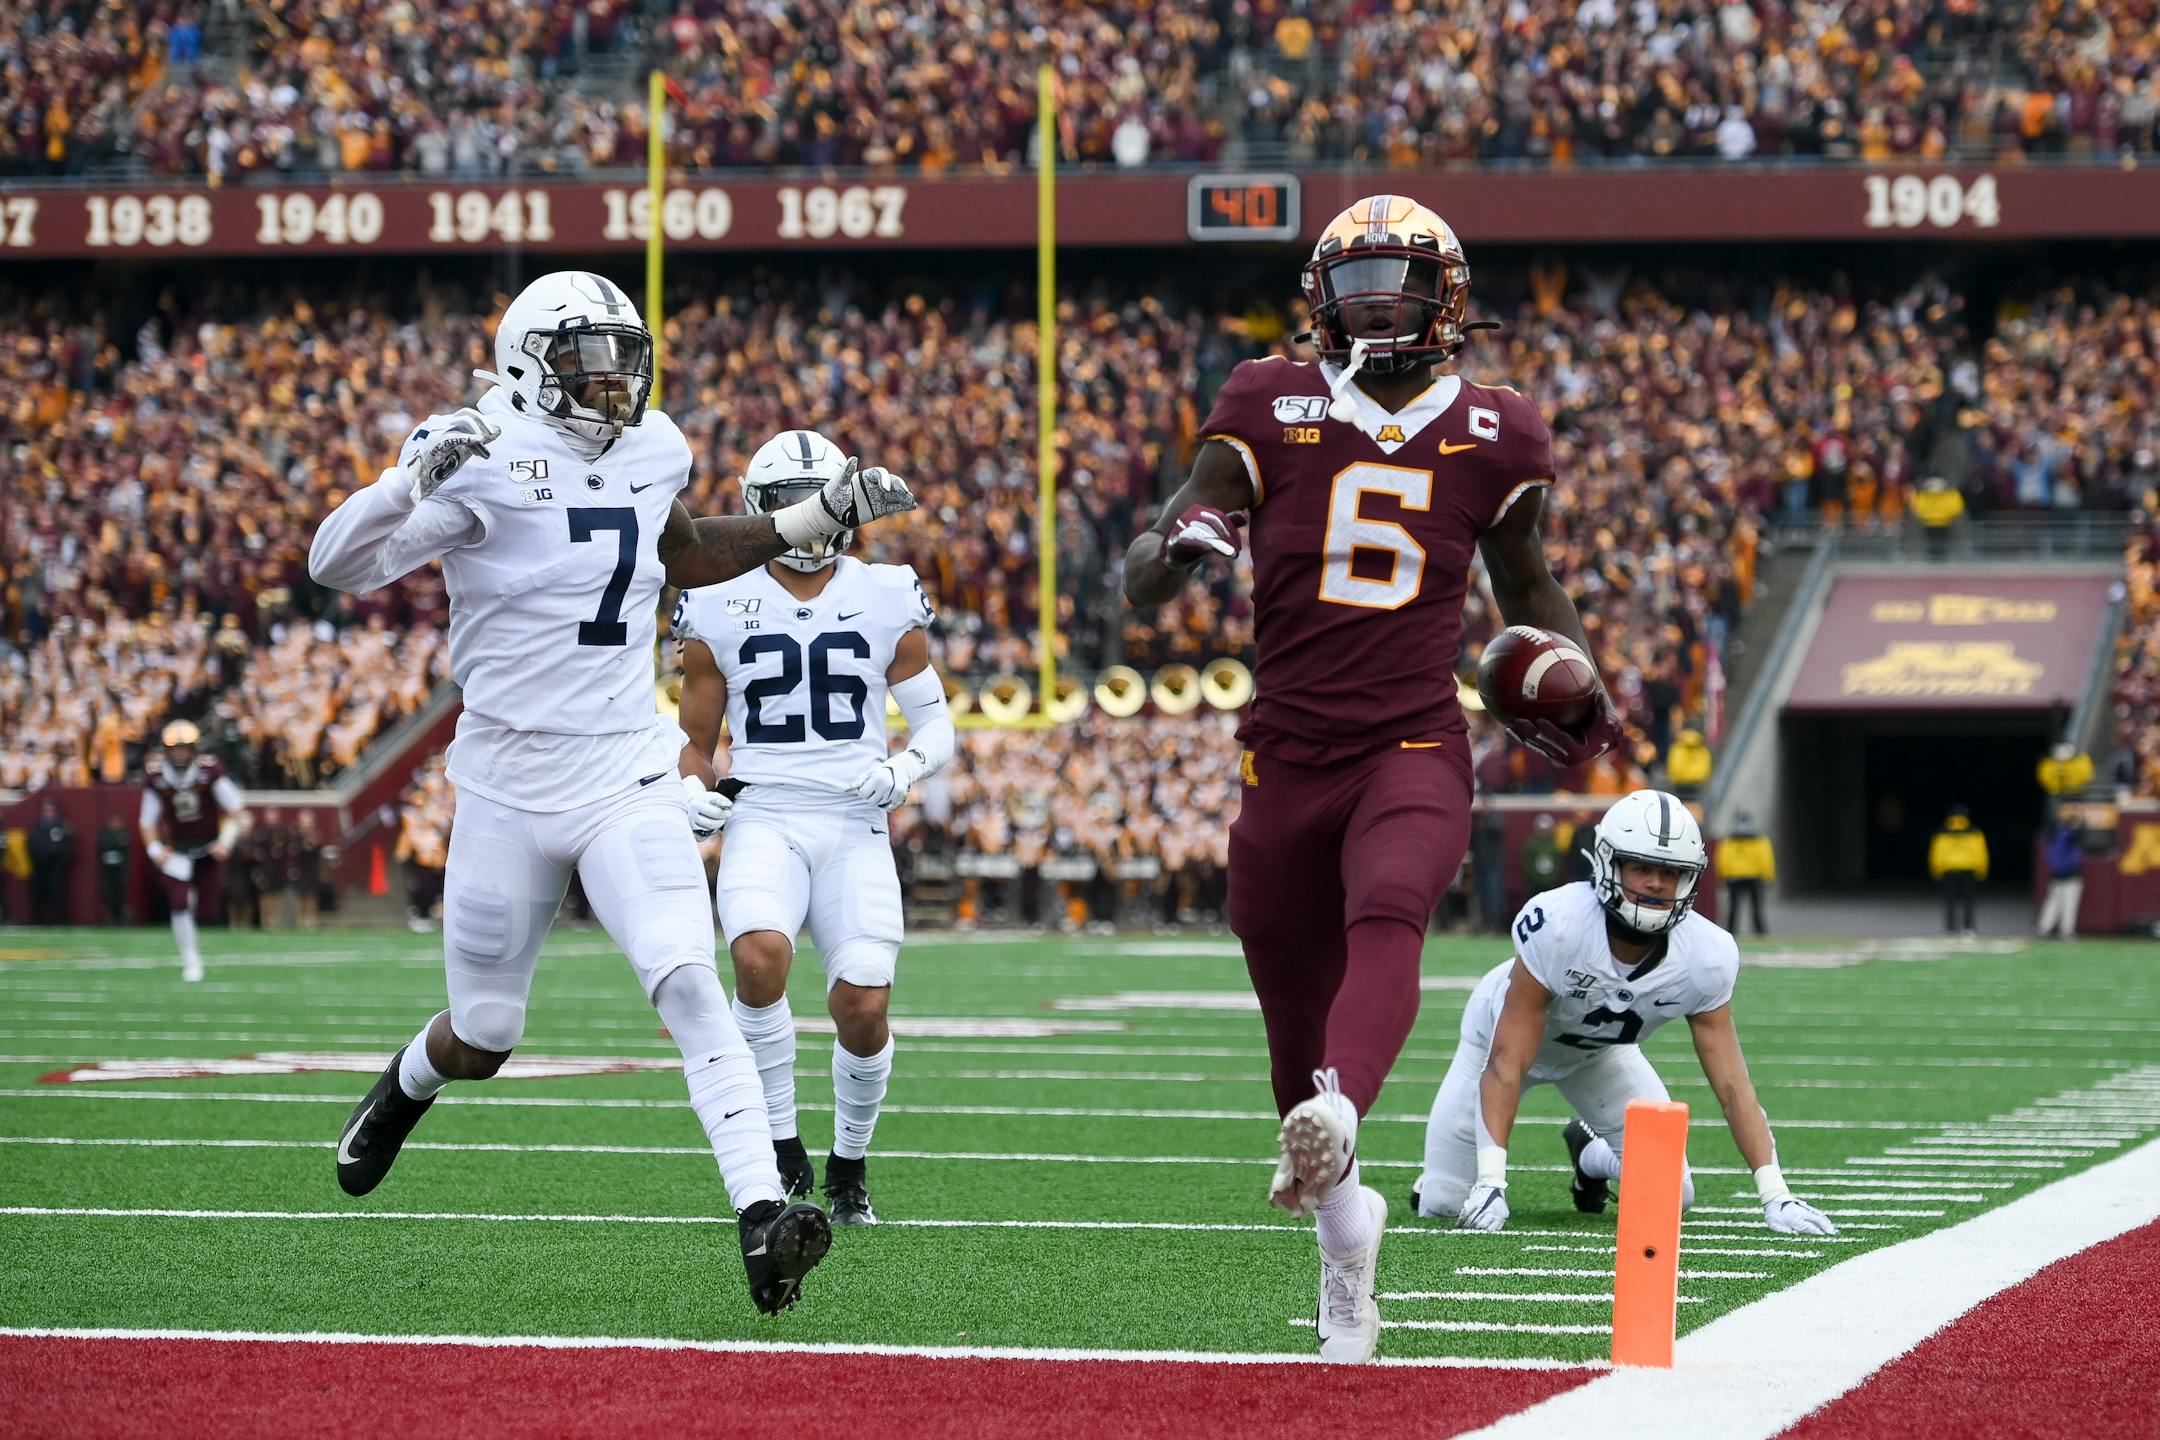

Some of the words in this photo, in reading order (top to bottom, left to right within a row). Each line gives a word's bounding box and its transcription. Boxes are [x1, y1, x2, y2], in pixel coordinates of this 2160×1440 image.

[0, 198, 38, 247] 7
[86, 195, 212, 246] 1938
[256, 192, 384, 244] 1940
[429, 190, 554, 242] 1941
[777, 186, 907, 239] 1967
[1211, 184, 1277, 228] 40
[1864, 174, 2000, 228] 1904
[1272, 396, 1329, 423] 150
[1472, 410, 1497, 440] C
[1377, 425, 1405, 442] M
[508, 460, 549, 483] 150
[1319, 461, 1434, 610] 6
[566, 506, 639, 646] 7
[725, 598, 761, 616] 150
[738, 631, 870, 744] 26
[1516, 907, 1545, 944] 2
[1563, 968, 1597, 988] 150
